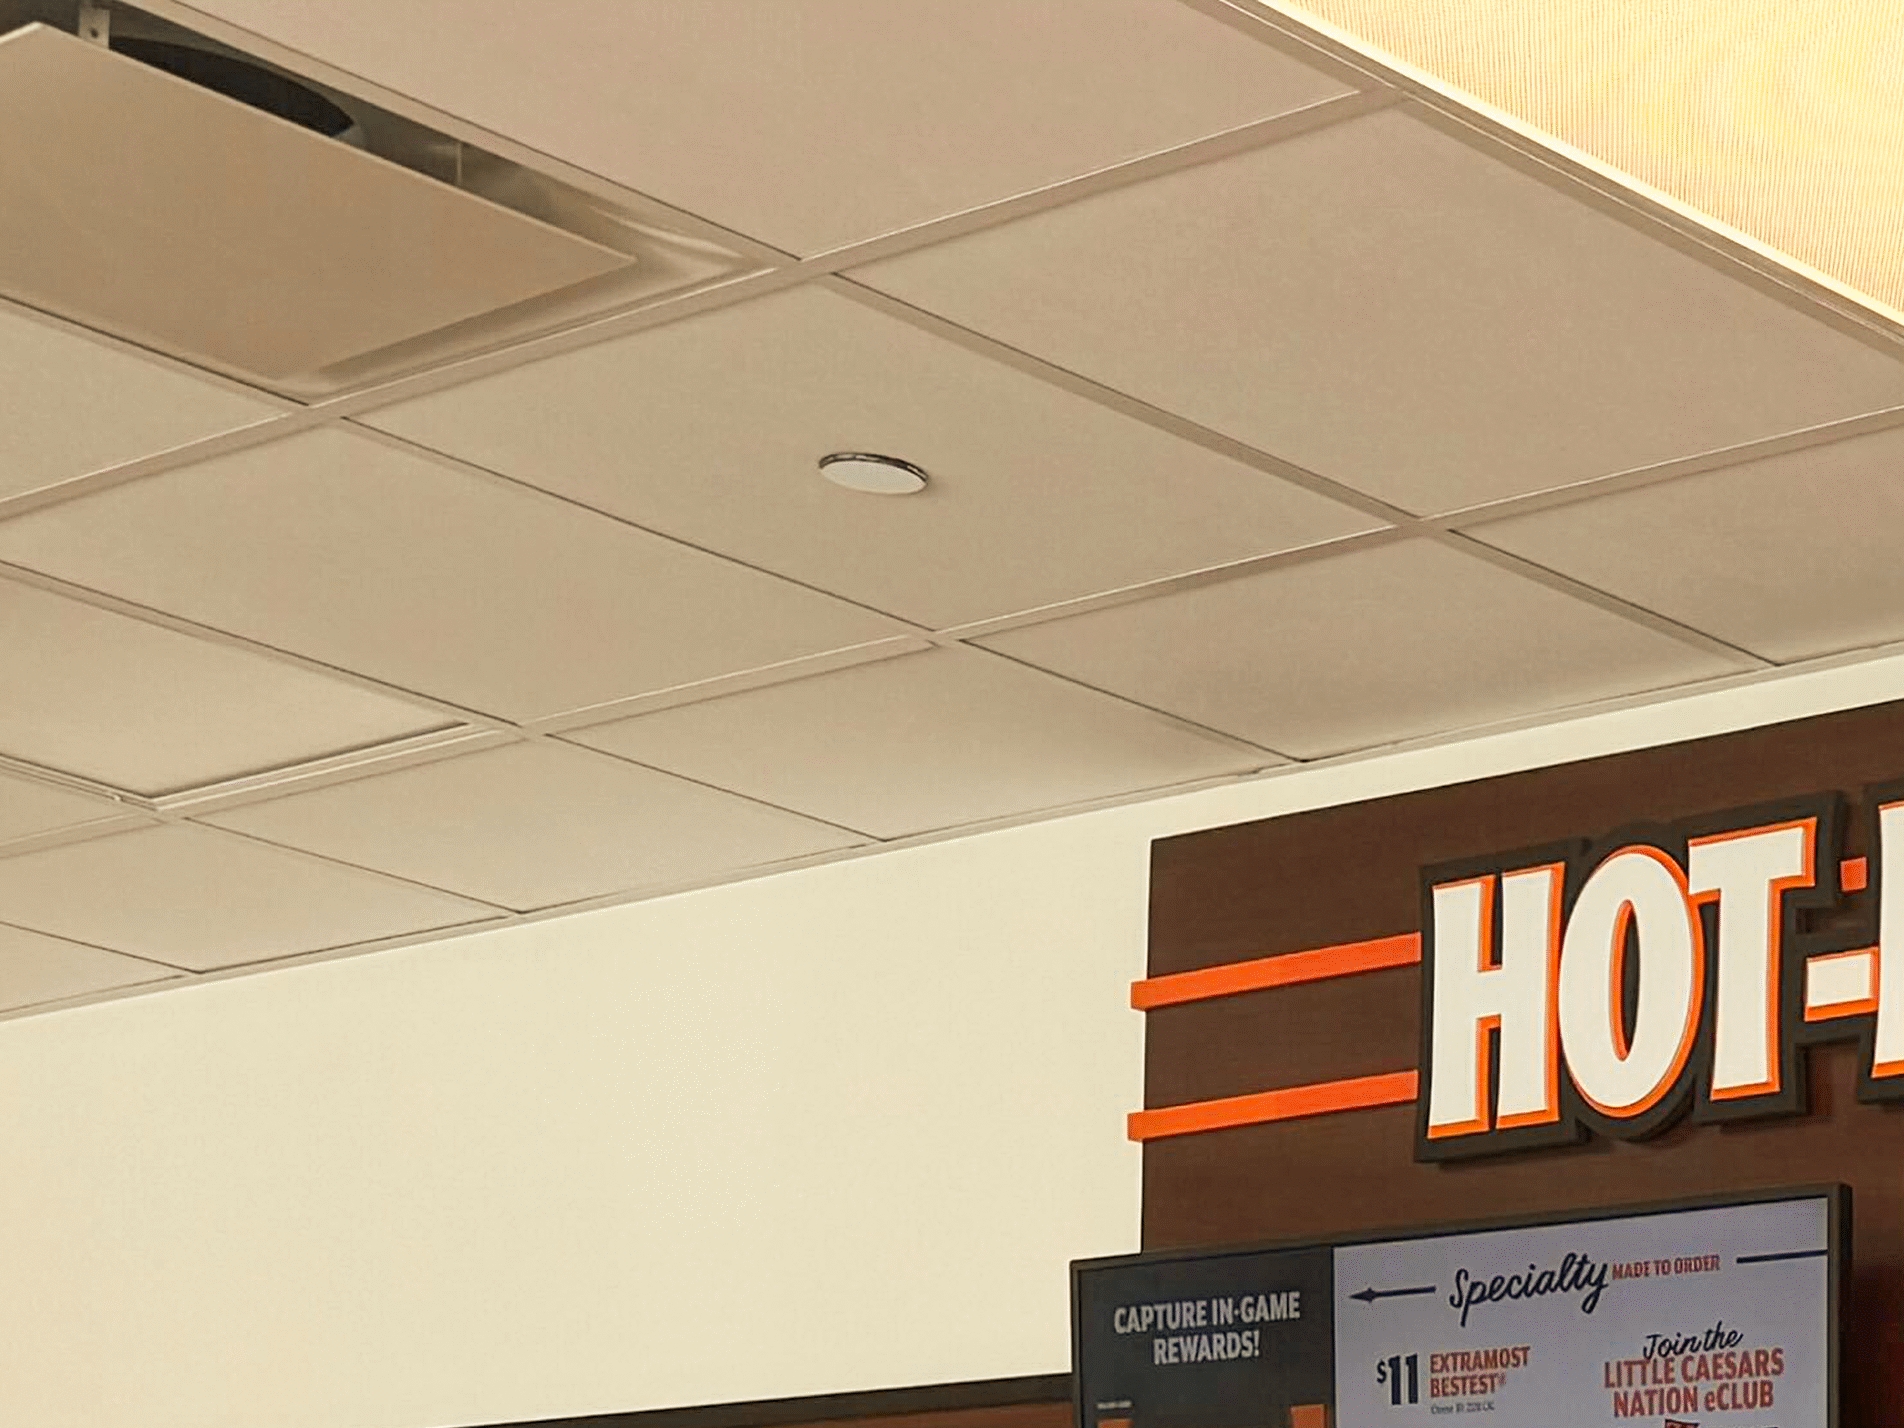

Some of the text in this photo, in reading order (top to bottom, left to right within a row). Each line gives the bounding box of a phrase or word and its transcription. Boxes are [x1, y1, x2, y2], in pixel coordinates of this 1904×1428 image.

[1449, 1251, 1610, 1327] Specialty
[1612, 1260, 1651, 1281] MADE
[1654, 1258, 1672, 1276] TO
[1114, 1301, 1208, 1334] CAPTURE
[1153, 1330, 1261, 1366] REWARDS!
[1643, 1320, 1744, 1360] Join the
[1376, 1345, 1531, 1406] $11 EXTRAMOST
[1604, 1347, 1785, 1389] LITTLE CAESARS
[1613, 1380, 1774, 1418] NATION eCLUB
